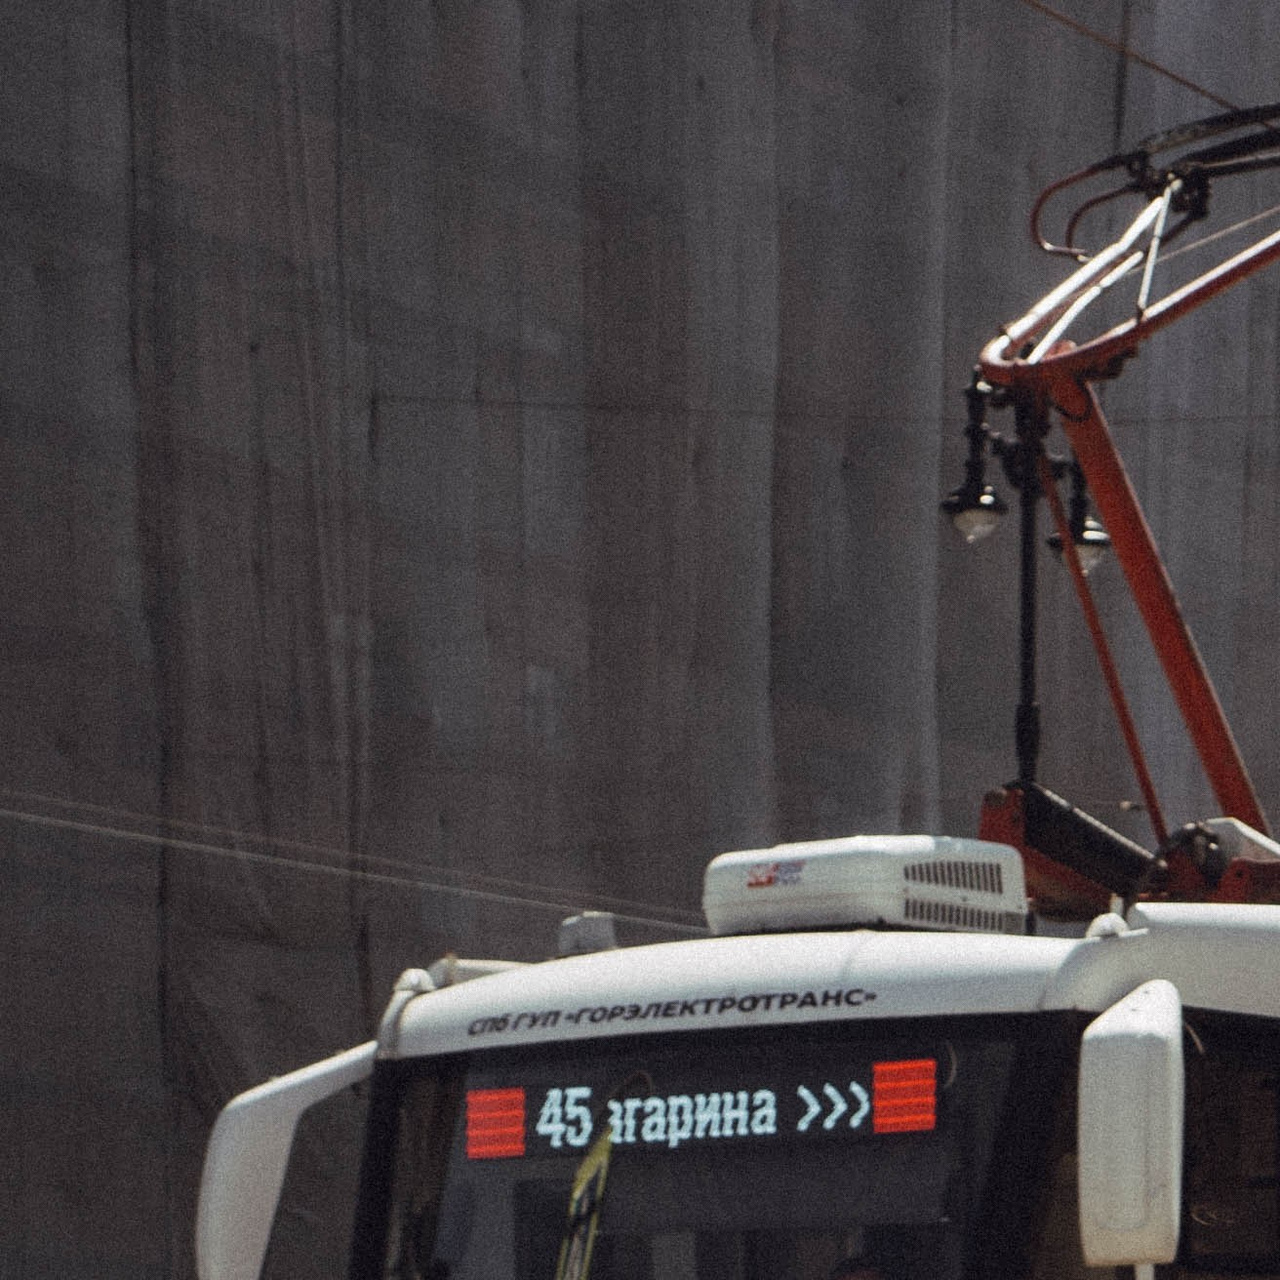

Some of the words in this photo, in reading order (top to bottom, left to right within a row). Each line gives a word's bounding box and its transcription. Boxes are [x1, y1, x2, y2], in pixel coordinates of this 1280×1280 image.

[511, 1010, 562, 1031] ГУП
[564, 988, 877, 1024] «ГОРЭЛЕКТРОТРАНС»
[535, 1087, 593, 1148] 45
